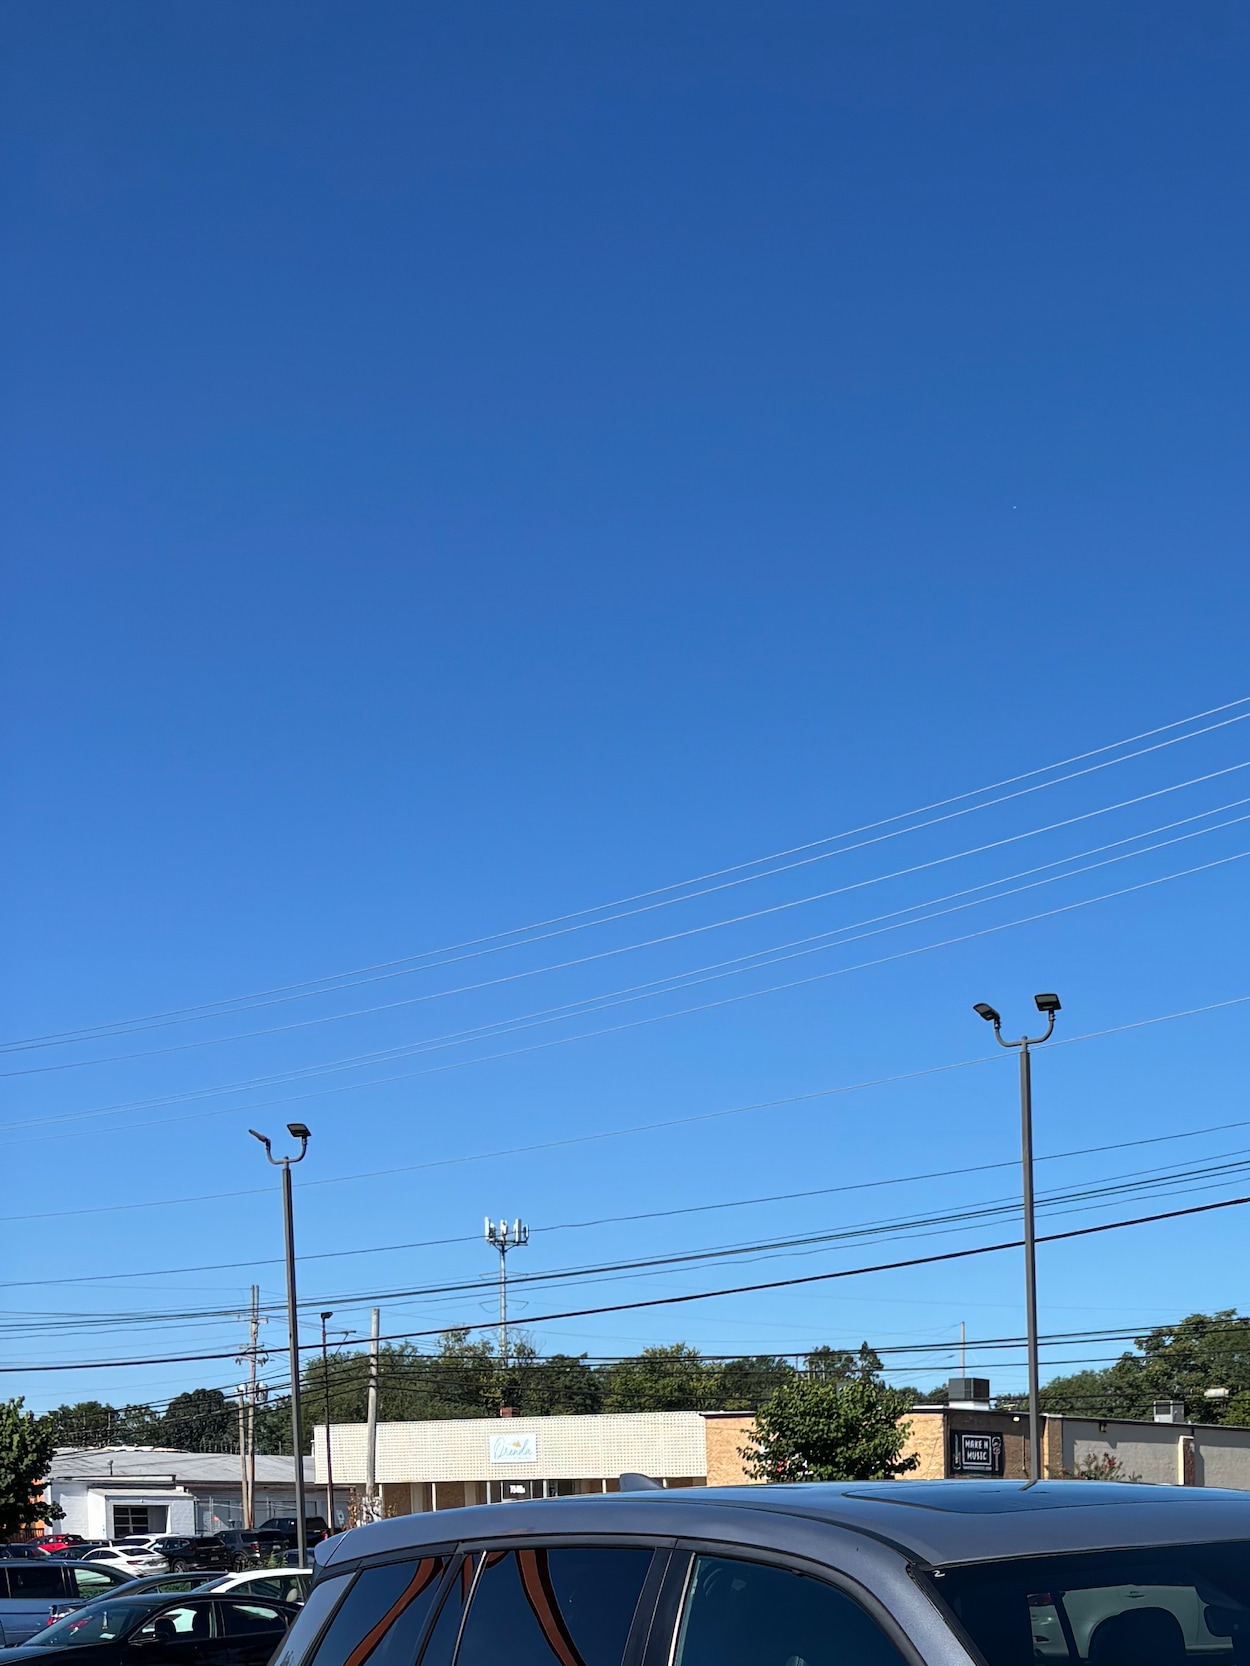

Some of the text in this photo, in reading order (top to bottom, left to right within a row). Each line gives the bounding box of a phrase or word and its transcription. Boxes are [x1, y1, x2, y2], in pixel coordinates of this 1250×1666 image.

[965, 1440, 989, 1449] MAKE N
[967, 1451, 987, 1460] MUSIC
